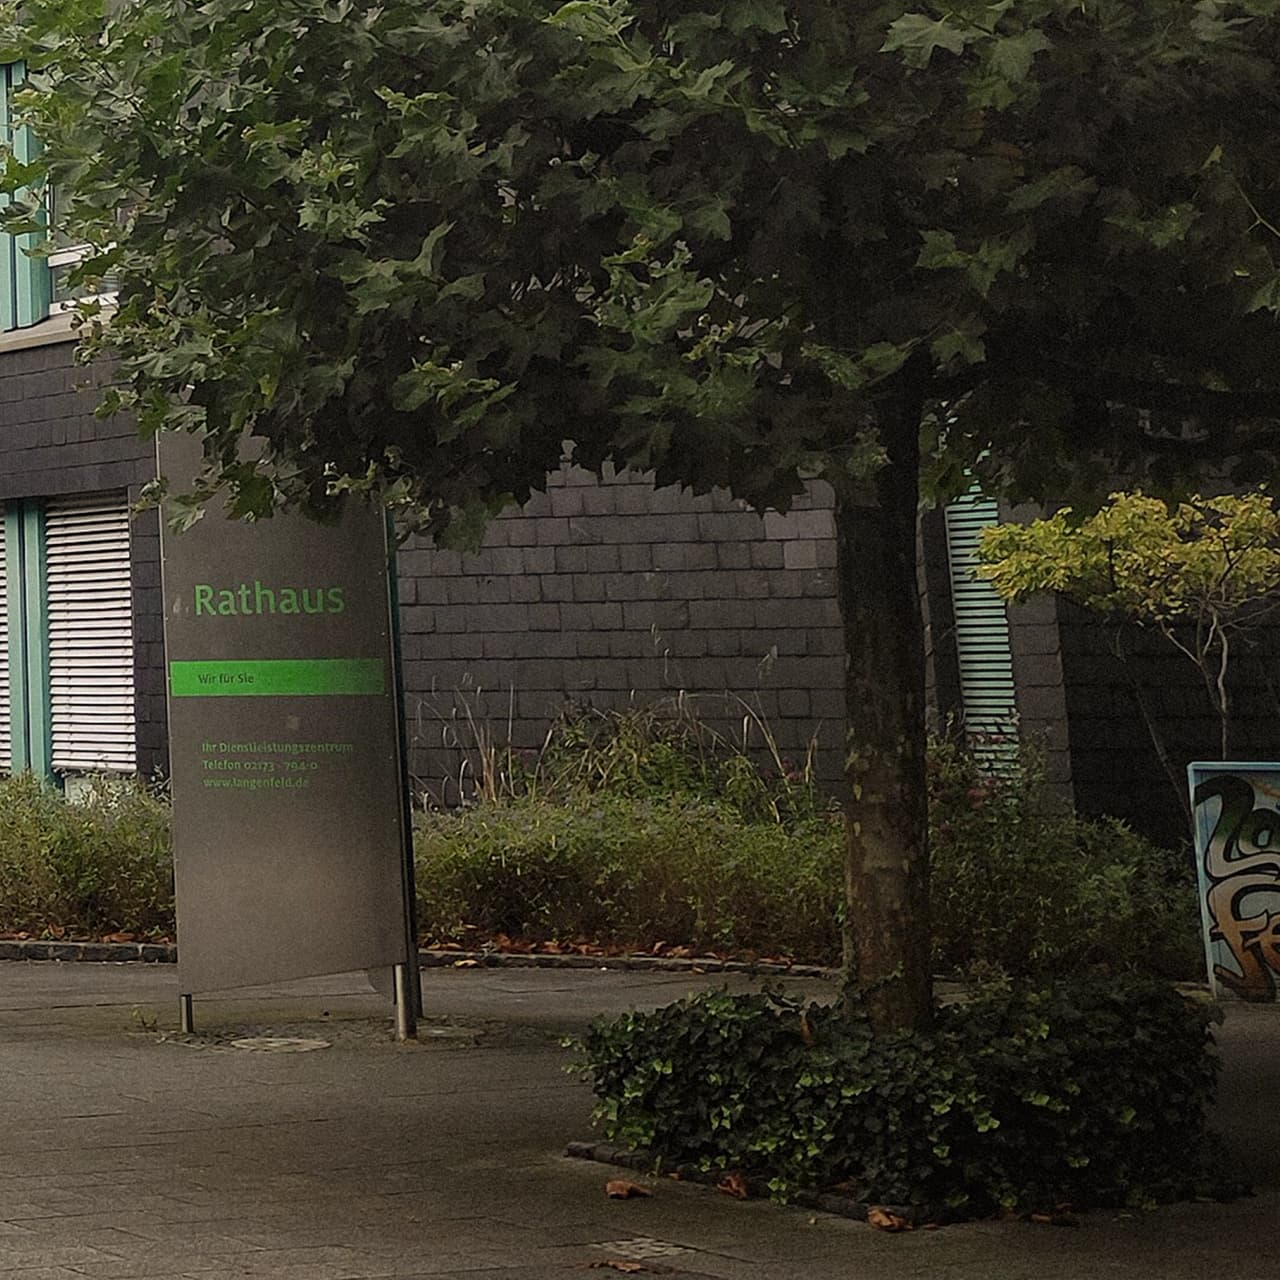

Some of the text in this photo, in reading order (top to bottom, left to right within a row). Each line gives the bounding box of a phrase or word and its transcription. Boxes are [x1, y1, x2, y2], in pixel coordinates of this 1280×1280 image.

[195, 581, 345, 616] Rathaus
[198, 672, 254, 684] Wir für Sie
[202, 741, 354, 754] Ihr Dienstleistungszentrum
[202, 759, 240, 770] Telefon
